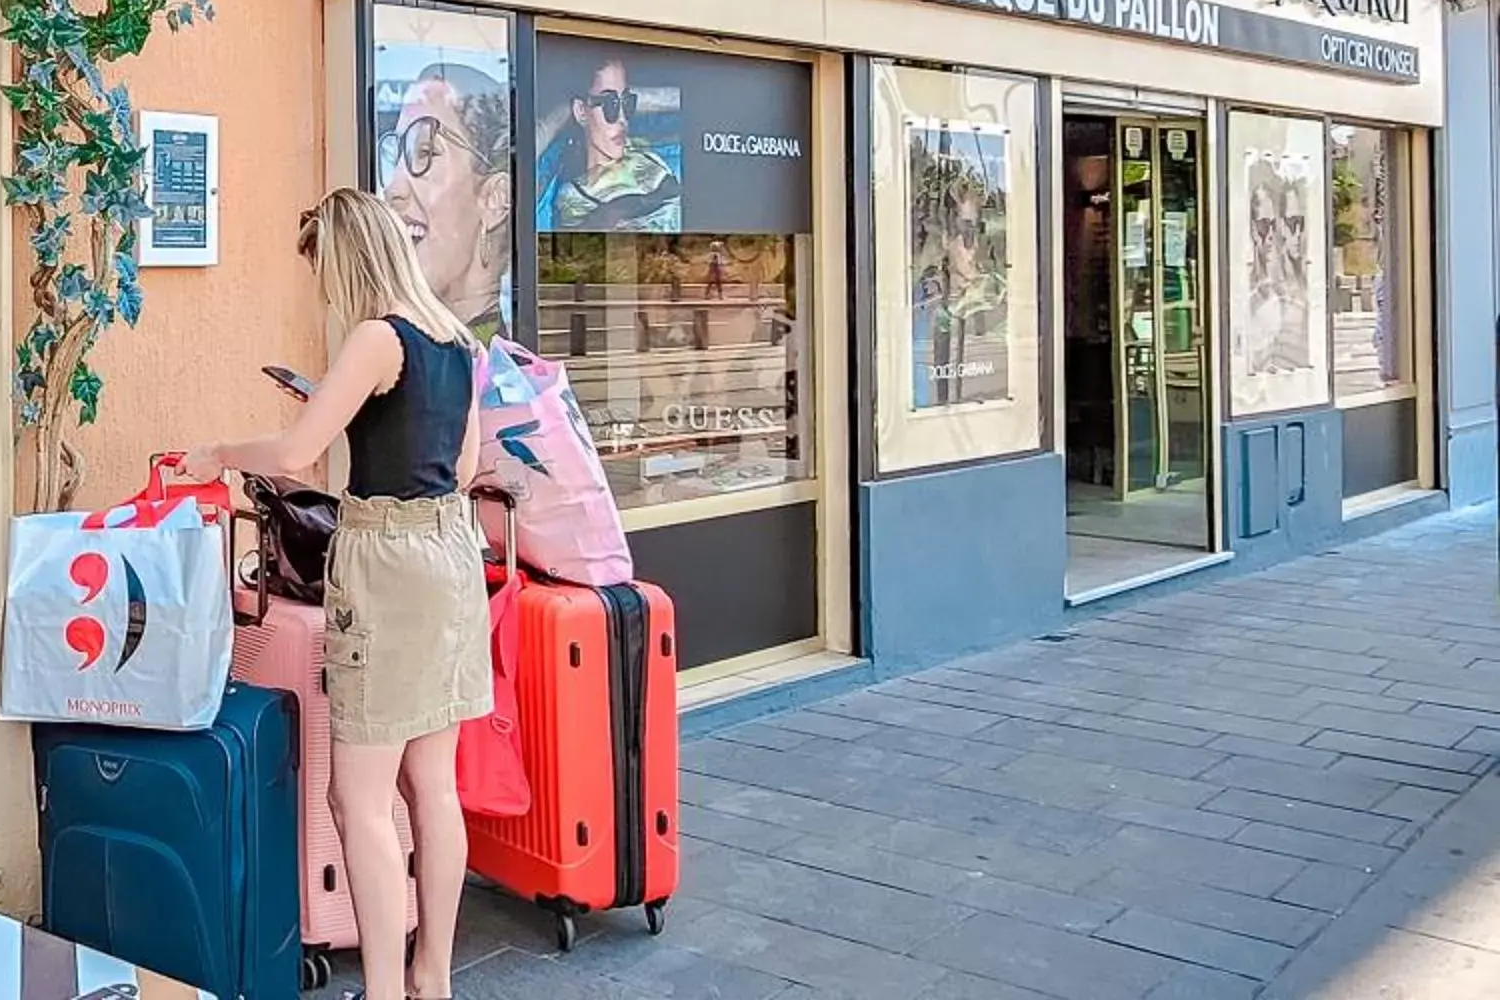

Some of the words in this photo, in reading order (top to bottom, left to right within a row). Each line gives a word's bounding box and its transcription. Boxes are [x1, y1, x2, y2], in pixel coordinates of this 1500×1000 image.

[1320, 34, 1374, 70] OPTICIEN
[1375, 44, 1420, 76] CONSEIL
[661, 403, 776, 434] GUESS
[66, 698, 141, 717] MONOPRIX
